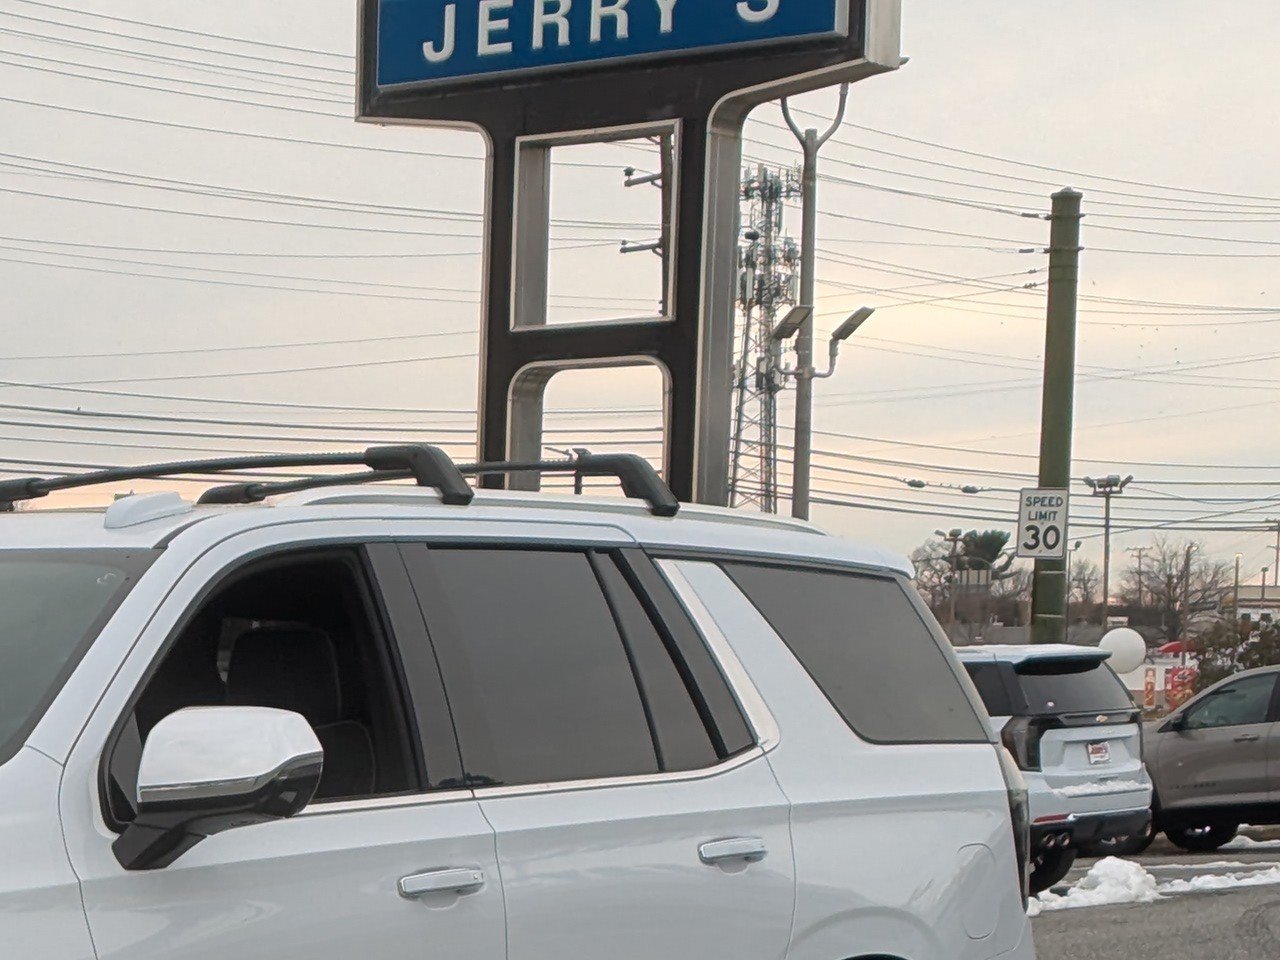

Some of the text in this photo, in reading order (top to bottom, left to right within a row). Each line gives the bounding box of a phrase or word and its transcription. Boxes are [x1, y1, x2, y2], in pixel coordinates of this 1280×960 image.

[422, 0, 780, 63] JERRY
[1025, 495, 1064, 508] SPEED
[1028, 510, 1059, 521] LIMIT
[1022, 524, 1061, 551] 30
